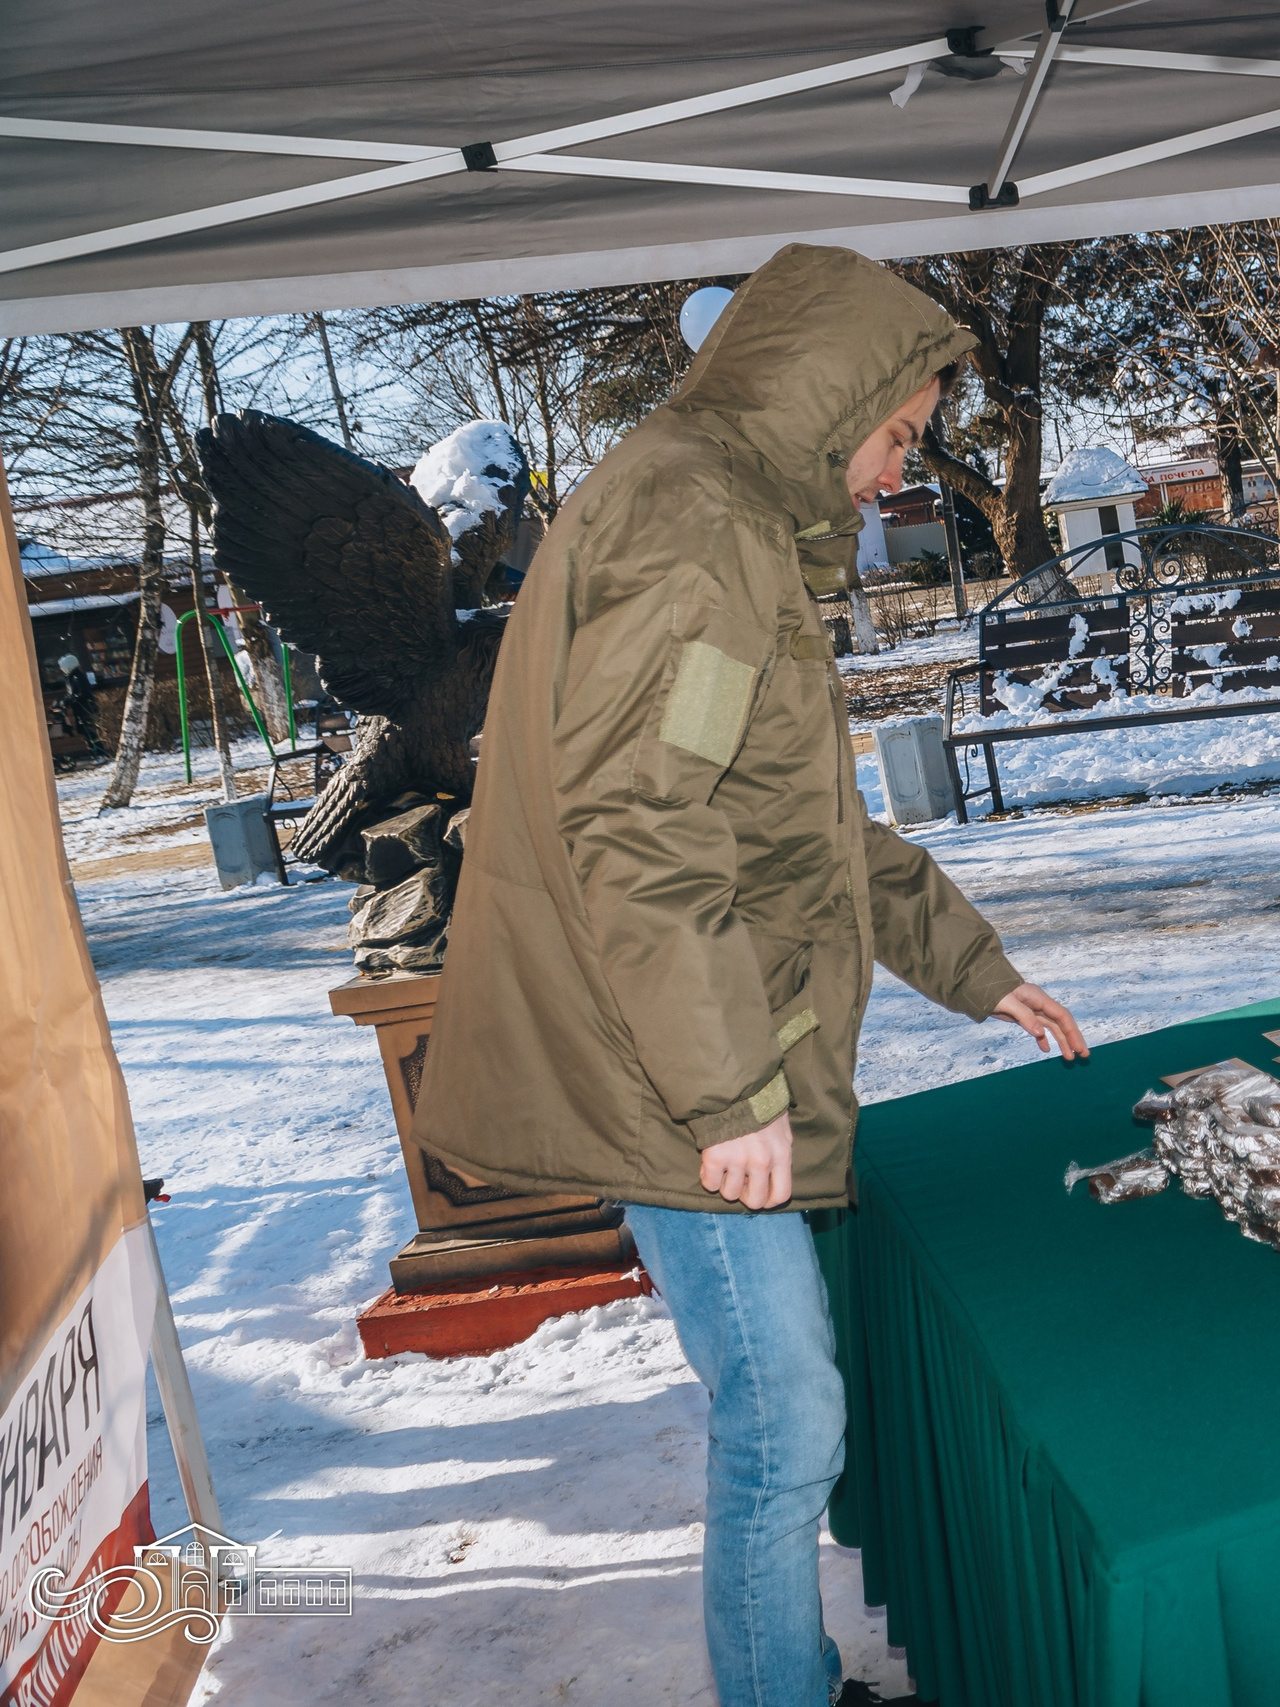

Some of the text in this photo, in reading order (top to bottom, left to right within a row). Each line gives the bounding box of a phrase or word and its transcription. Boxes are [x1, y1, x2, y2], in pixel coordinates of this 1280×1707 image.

[1160, 469, 1205, 481] ПОЧЕТА
[0, 1297, 101, 1553] НВАРЯ
[11, 1434, 103, 1601] ОСВОБОЖДЕНИЯ
